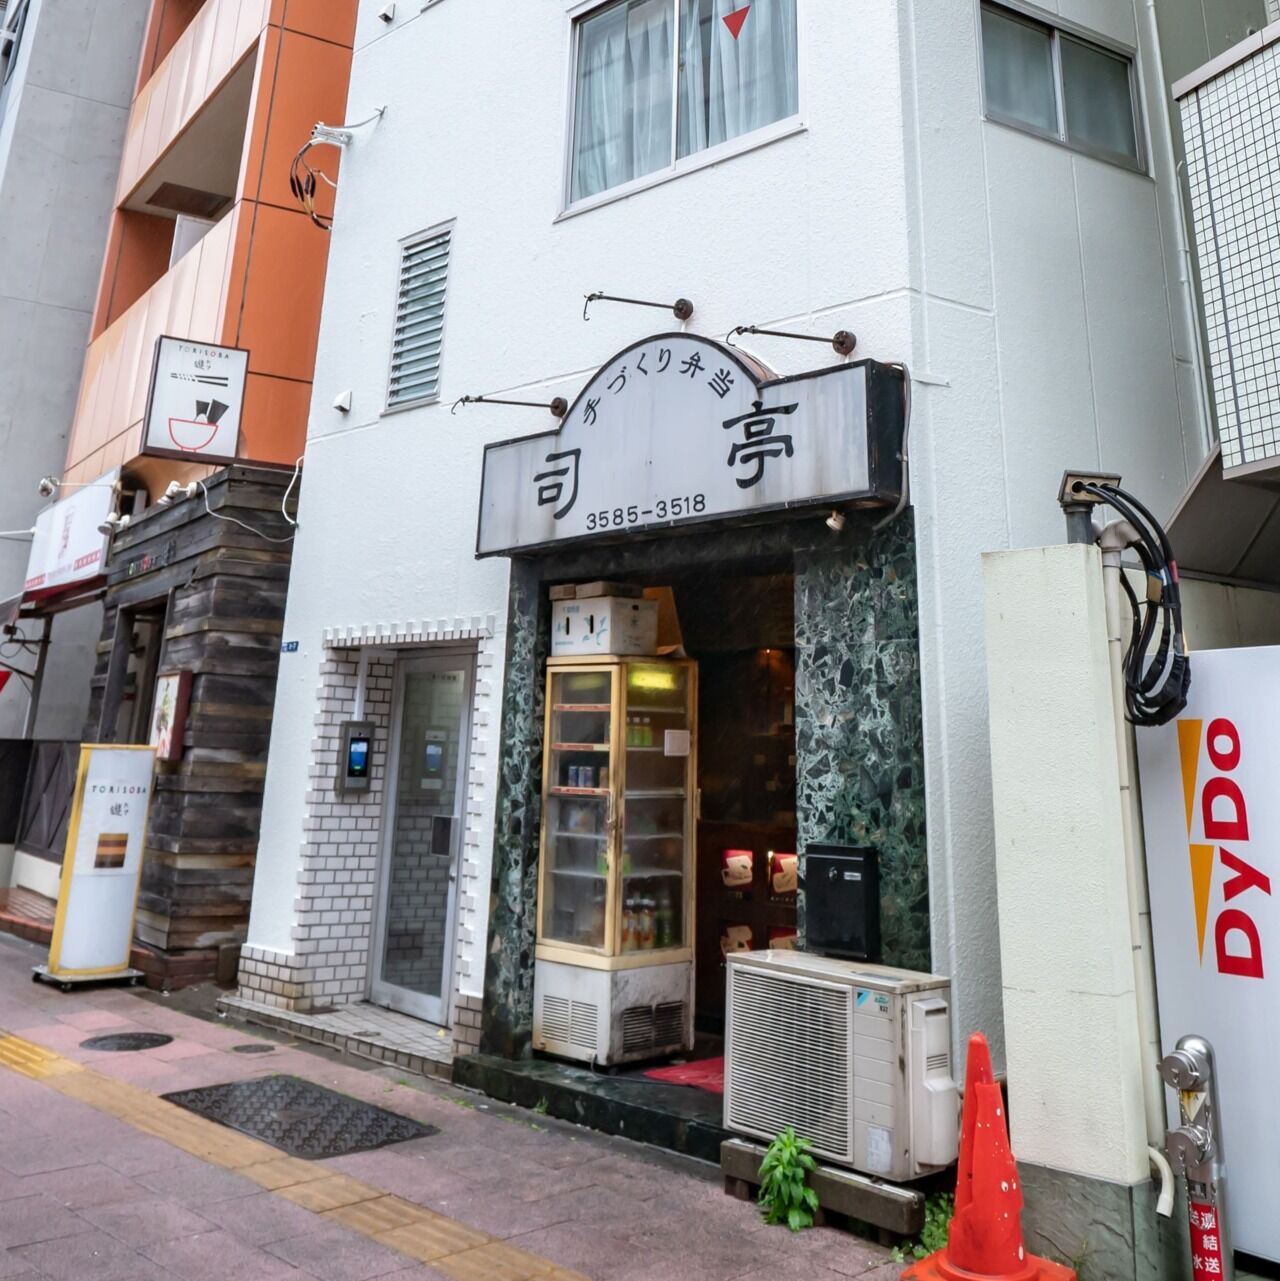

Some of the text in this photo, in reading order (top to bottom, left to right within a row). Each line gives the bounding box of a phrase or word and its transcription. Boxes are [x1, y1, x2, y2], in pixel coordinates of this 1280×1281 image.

[581, 346, 736, 427] 手づくり弁当
[585, 492, 707, 532] 3585-3518
[1202, 716, 1272, 980] DyDo
